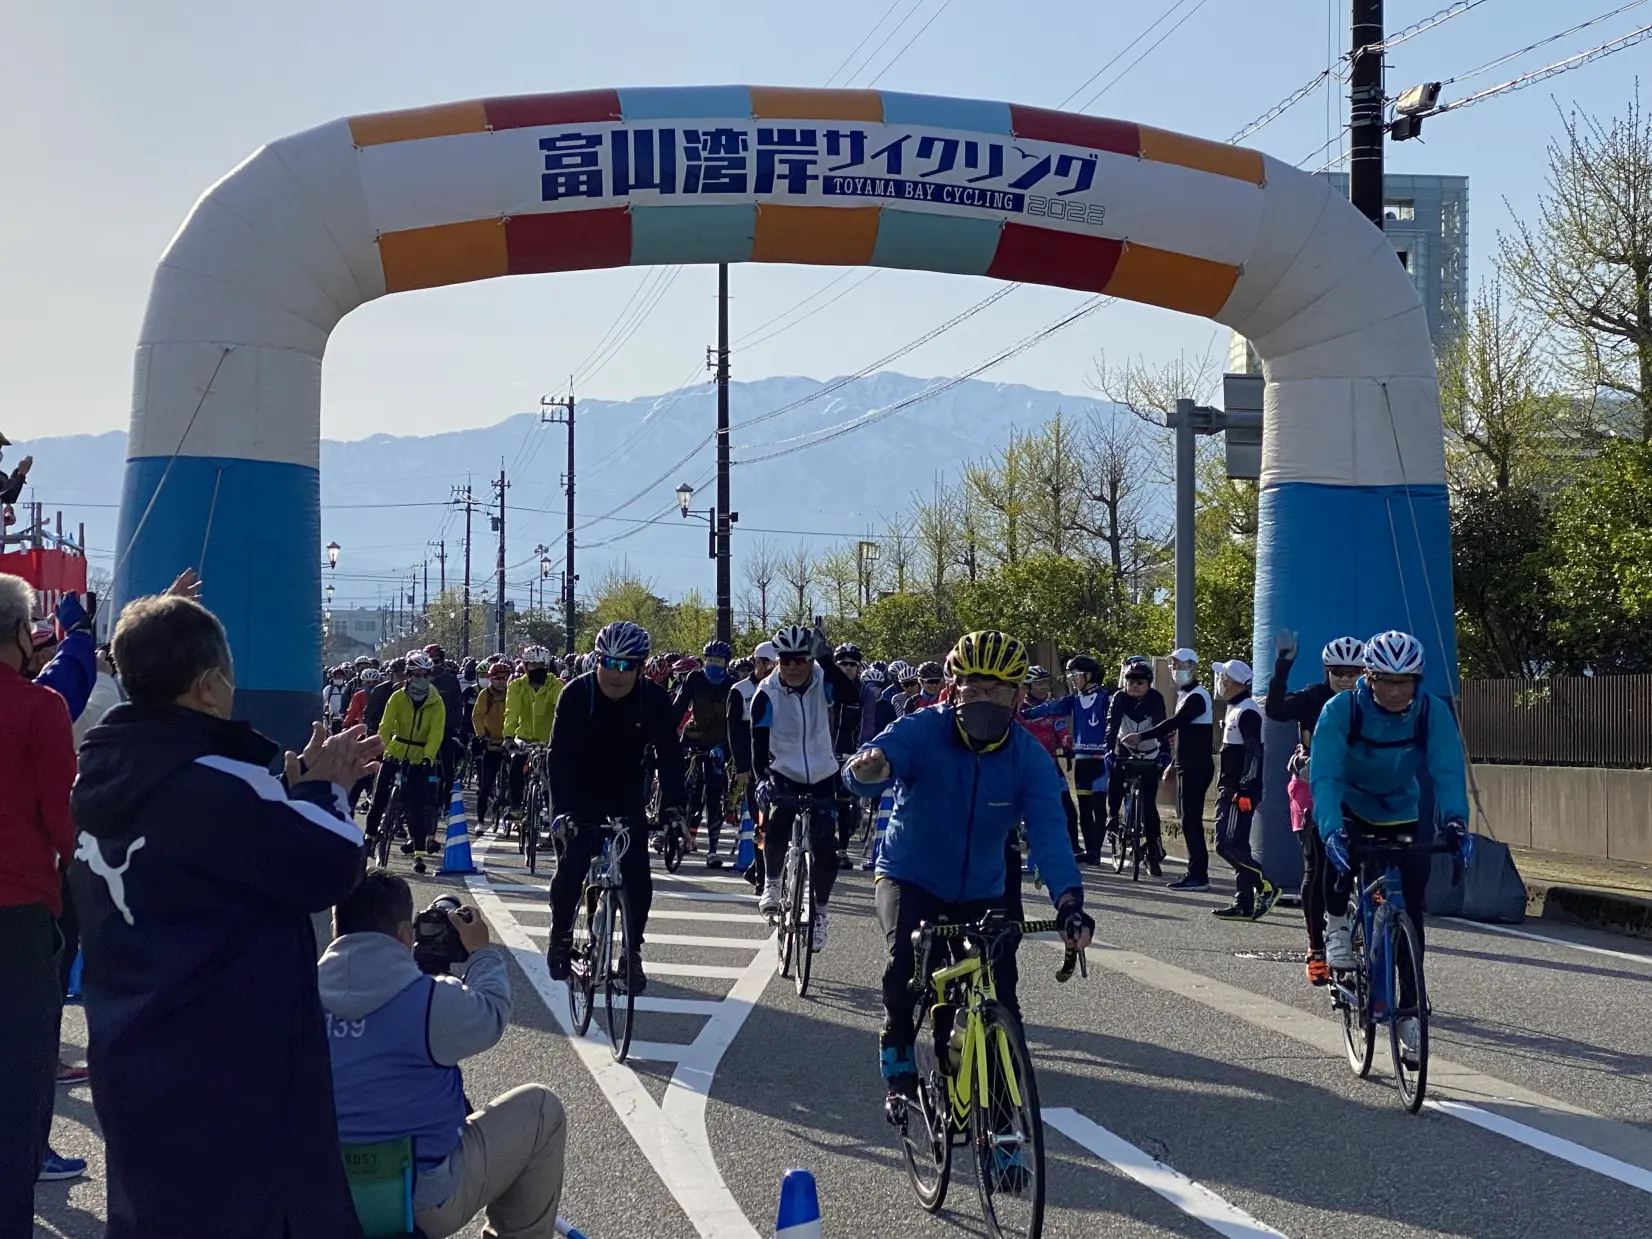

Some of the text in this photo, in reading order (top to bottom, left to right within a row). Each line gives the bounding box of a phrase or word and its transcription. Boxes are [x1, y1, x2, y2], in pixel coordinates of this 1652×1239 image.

[539, 128, 1099, 201] 富山湾岸サイクリング
[833, 177, 1106, 226] TOYAMA BAY CYCLING 2022
